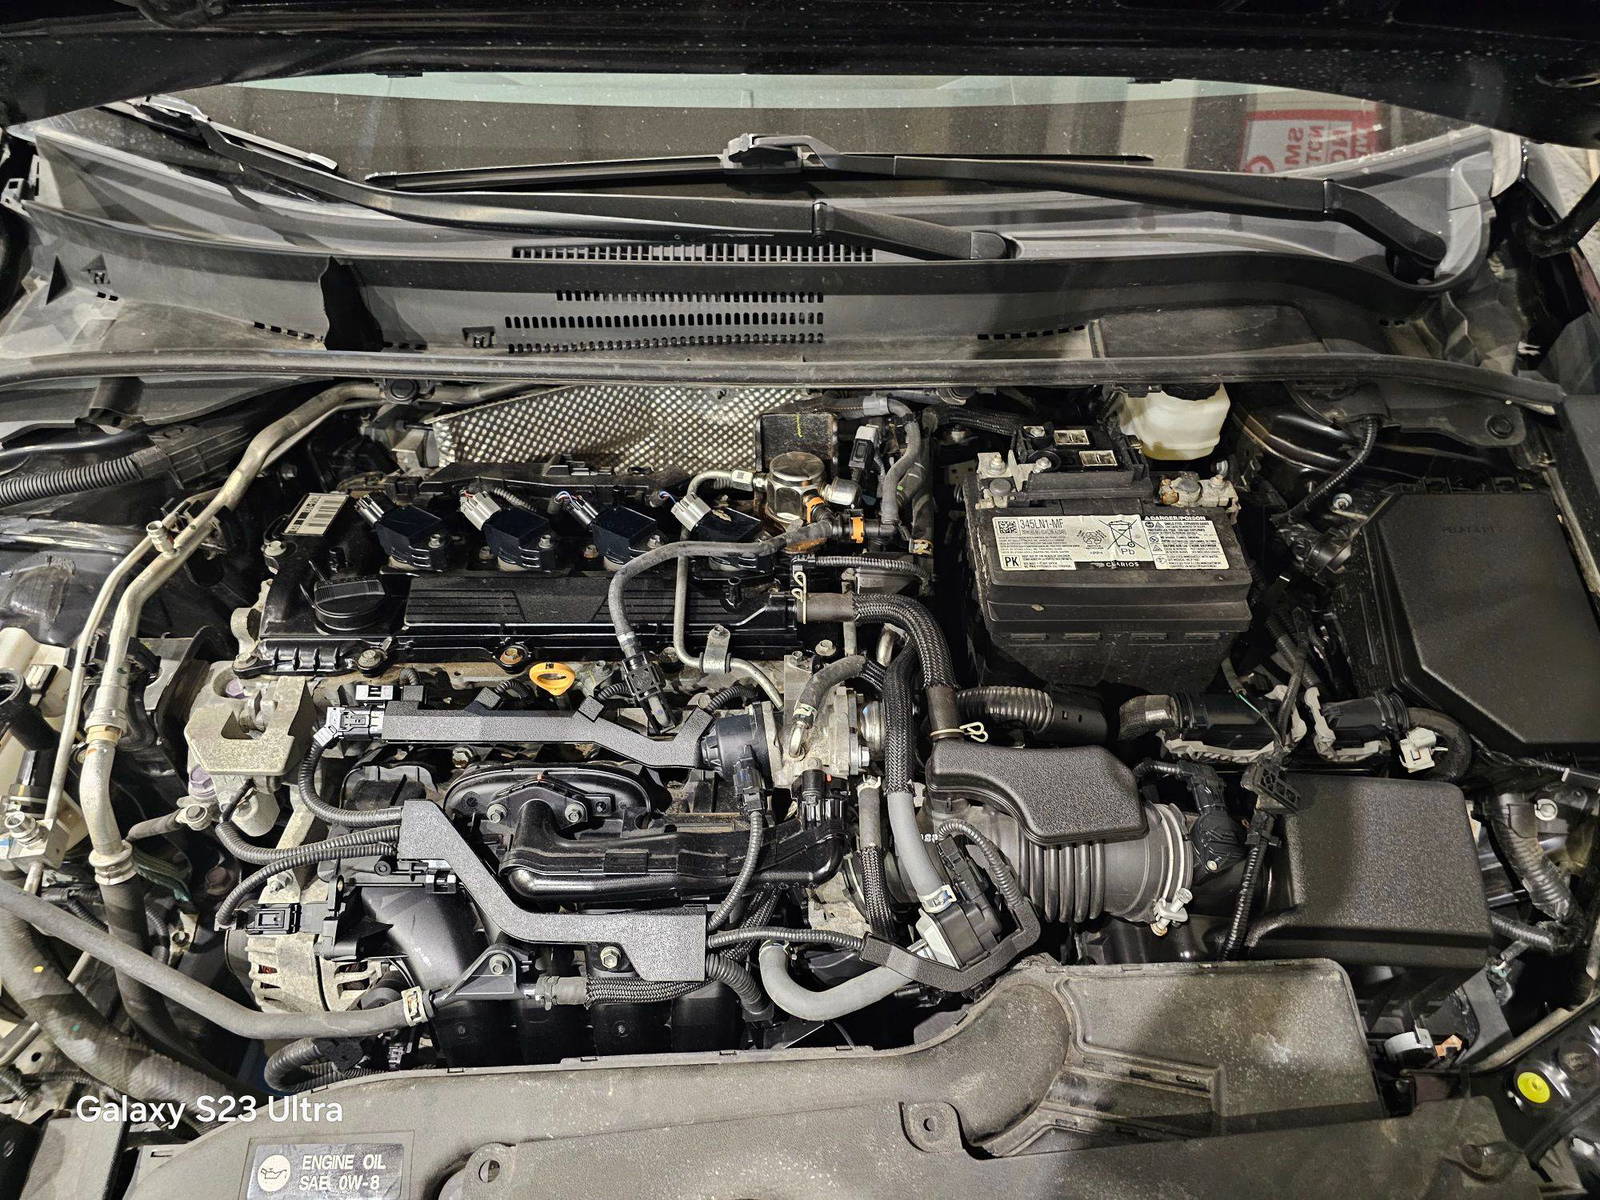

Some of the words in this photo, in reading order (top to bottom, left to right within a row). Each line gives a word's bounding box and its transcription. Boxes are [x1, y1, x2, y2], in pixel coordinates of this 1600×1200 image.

[1020, 518, 1064, 529] 345LN1-MF
[1004, 556, 1019, 567] PK
[302, 1154, 354, 1170] ENGINE
[363, 1154, 387, 1170] OIL
[299, 1175, 330, 1191] SAE
